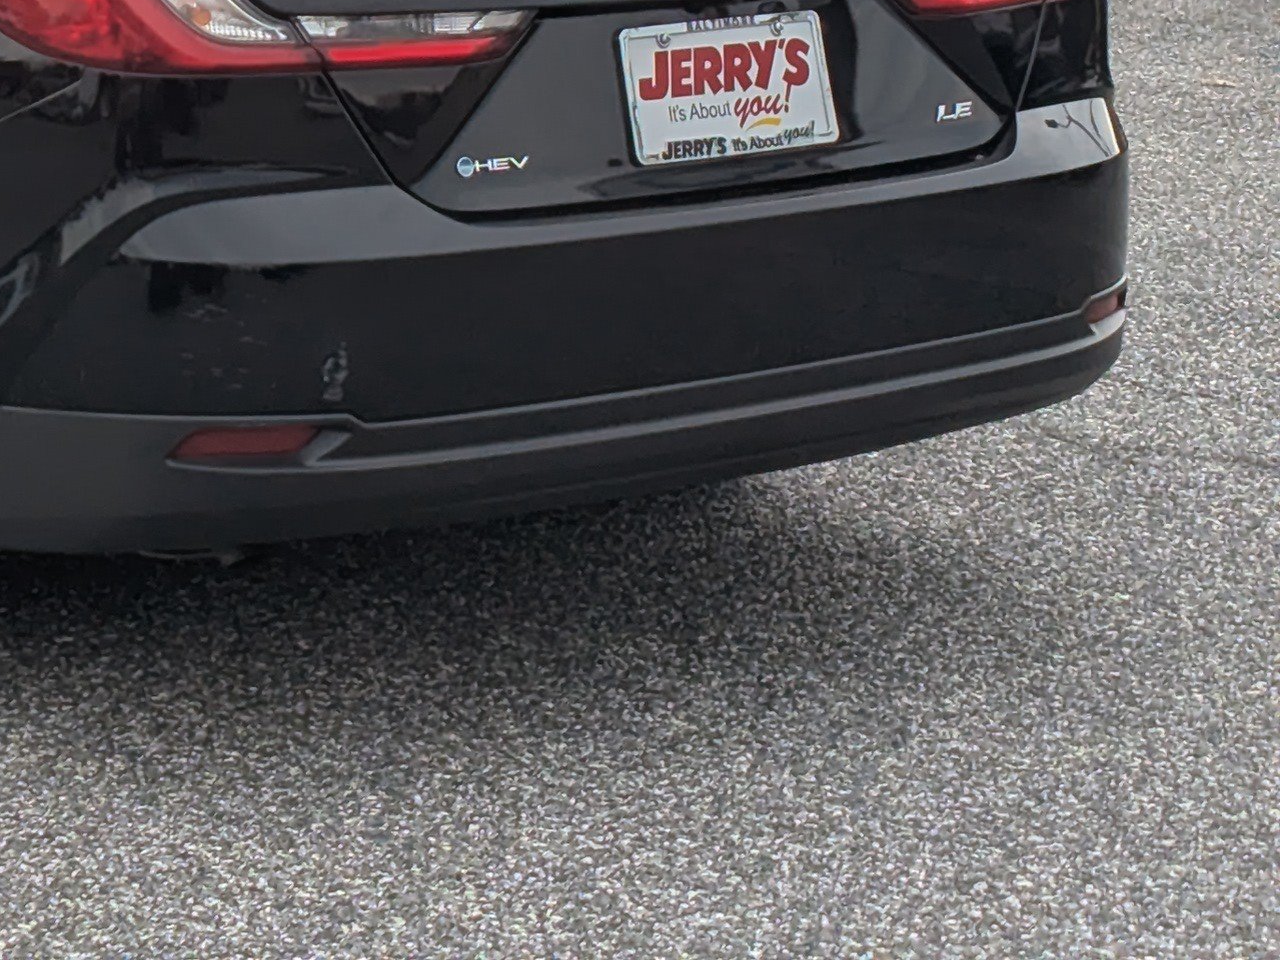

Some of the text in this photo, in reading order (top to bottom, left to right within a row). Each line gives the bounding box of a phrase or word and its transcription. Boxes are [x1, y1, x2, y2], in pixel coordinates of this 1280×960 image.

[638, 37, 811, 101] JERRY'S
[668, 84, 791, 129] It's About you!
[936, 100, 973, 122] LE
[661, 120, 815, 161] JERRY'S It's About you!
[474, 156, 529, 172] HEV
